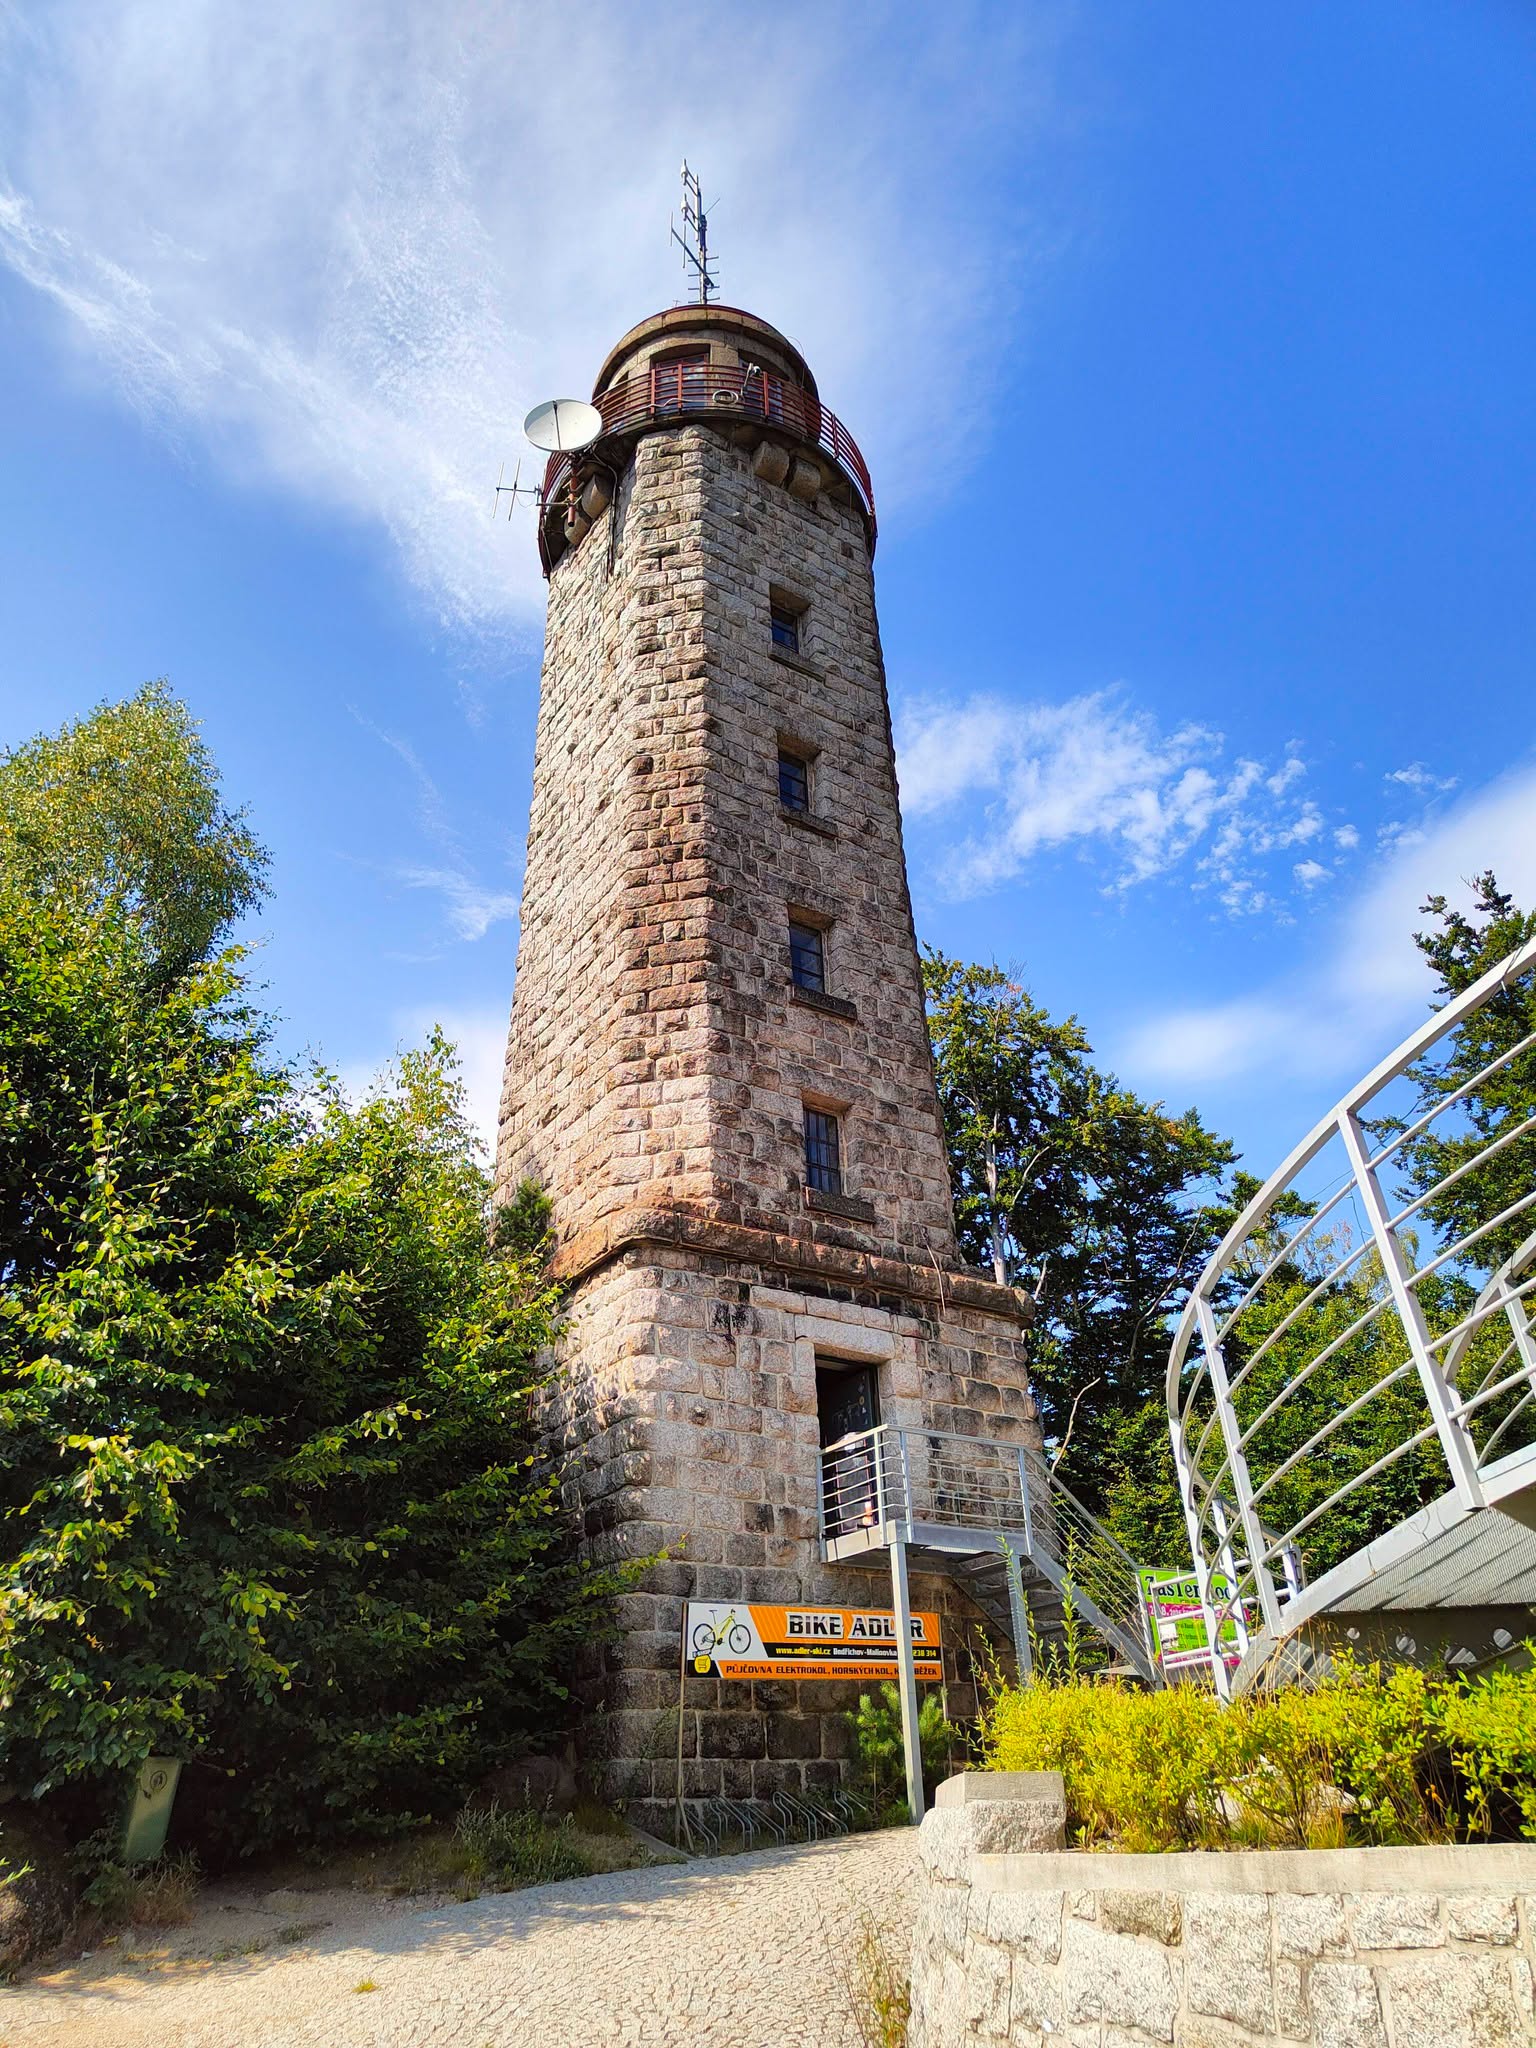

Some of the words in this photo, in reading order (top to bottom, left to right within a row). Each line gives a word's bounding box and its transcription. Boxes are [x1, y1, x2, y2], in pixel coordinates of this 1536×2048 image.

[788, 1614, 842, 1636] BIKE
[851, 1616, 924, 1638] ADLR
[726, 1663, 773, 1674] PŮJČOVNA
[776, 1666, 831, 1675] ELEKTROKOL,
[832, 1665, 874, 1675] HORSKÝCH
[875, 1667, 893, 1676] KOL,
